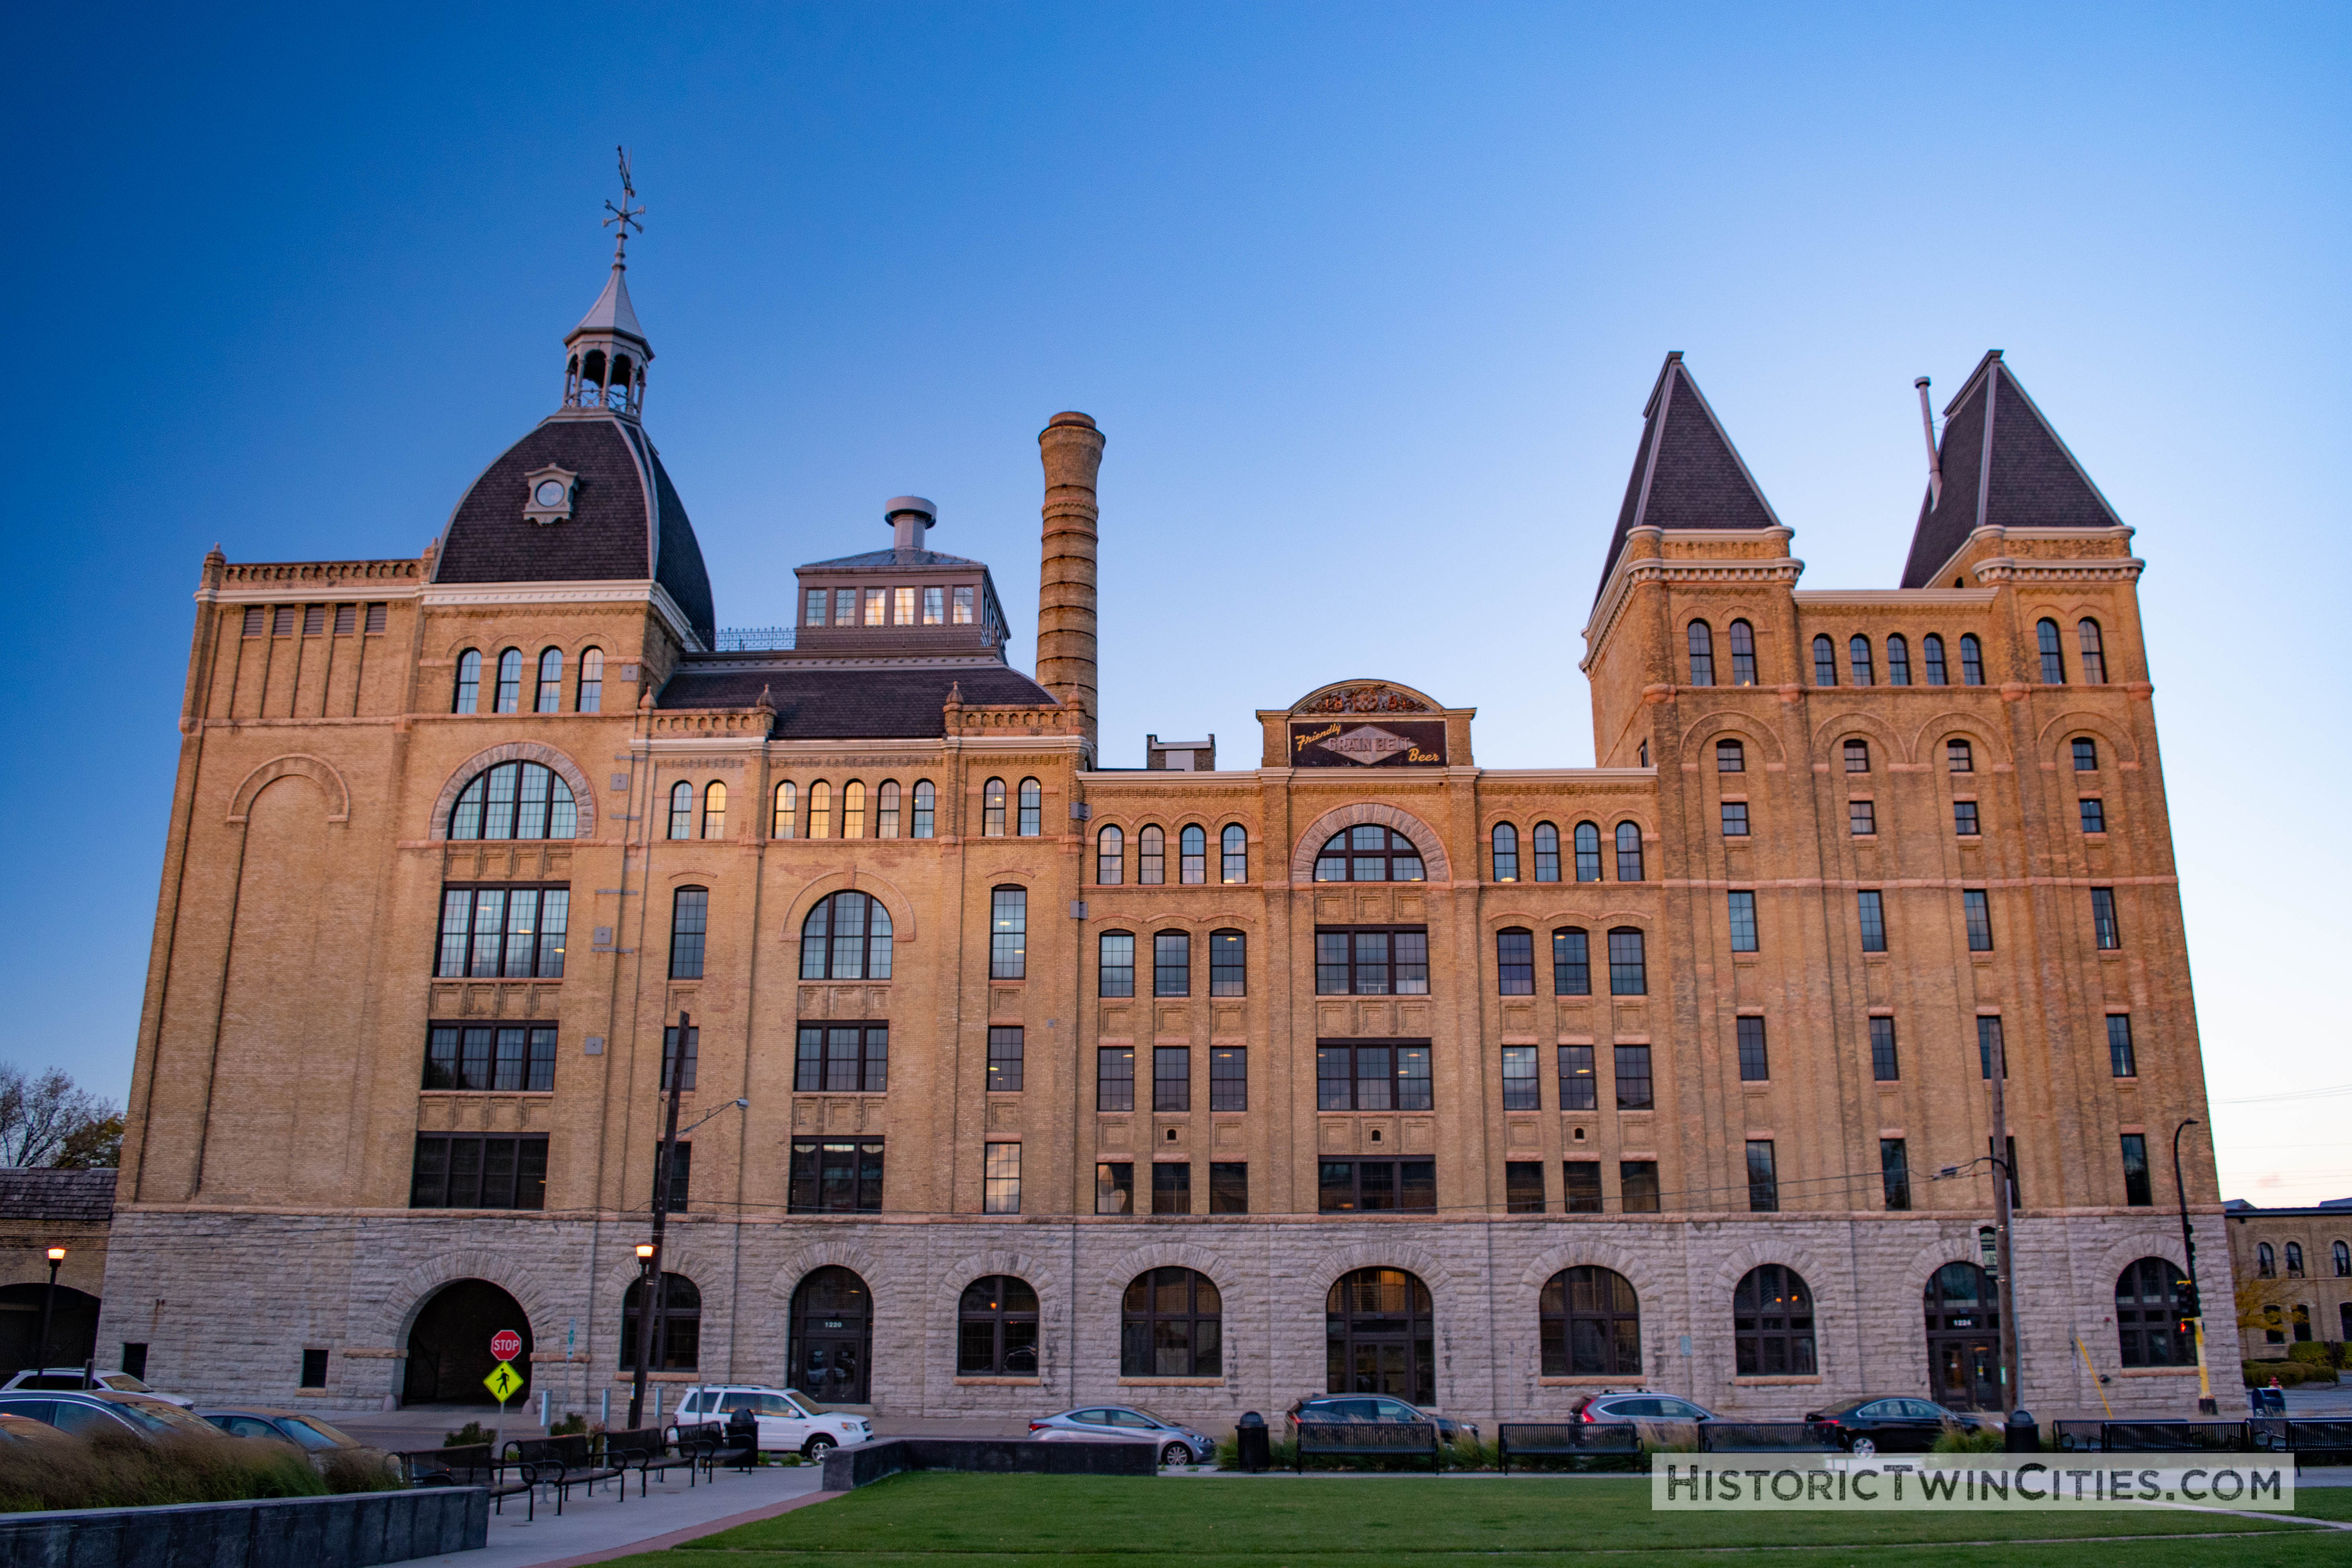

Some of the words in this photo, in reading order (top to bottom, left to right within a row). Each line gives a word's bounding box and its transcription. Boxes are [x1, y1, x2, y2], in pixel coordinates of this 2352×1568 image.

[1295, 723, 1341, 751] Friendly
[1328, 738, 1371, 751] GRAIN
[1375, 737, 1410, 751] BELT
[1408, 748, 1440, 762] Beer
[494, 1339, 519, 1351] STOP
